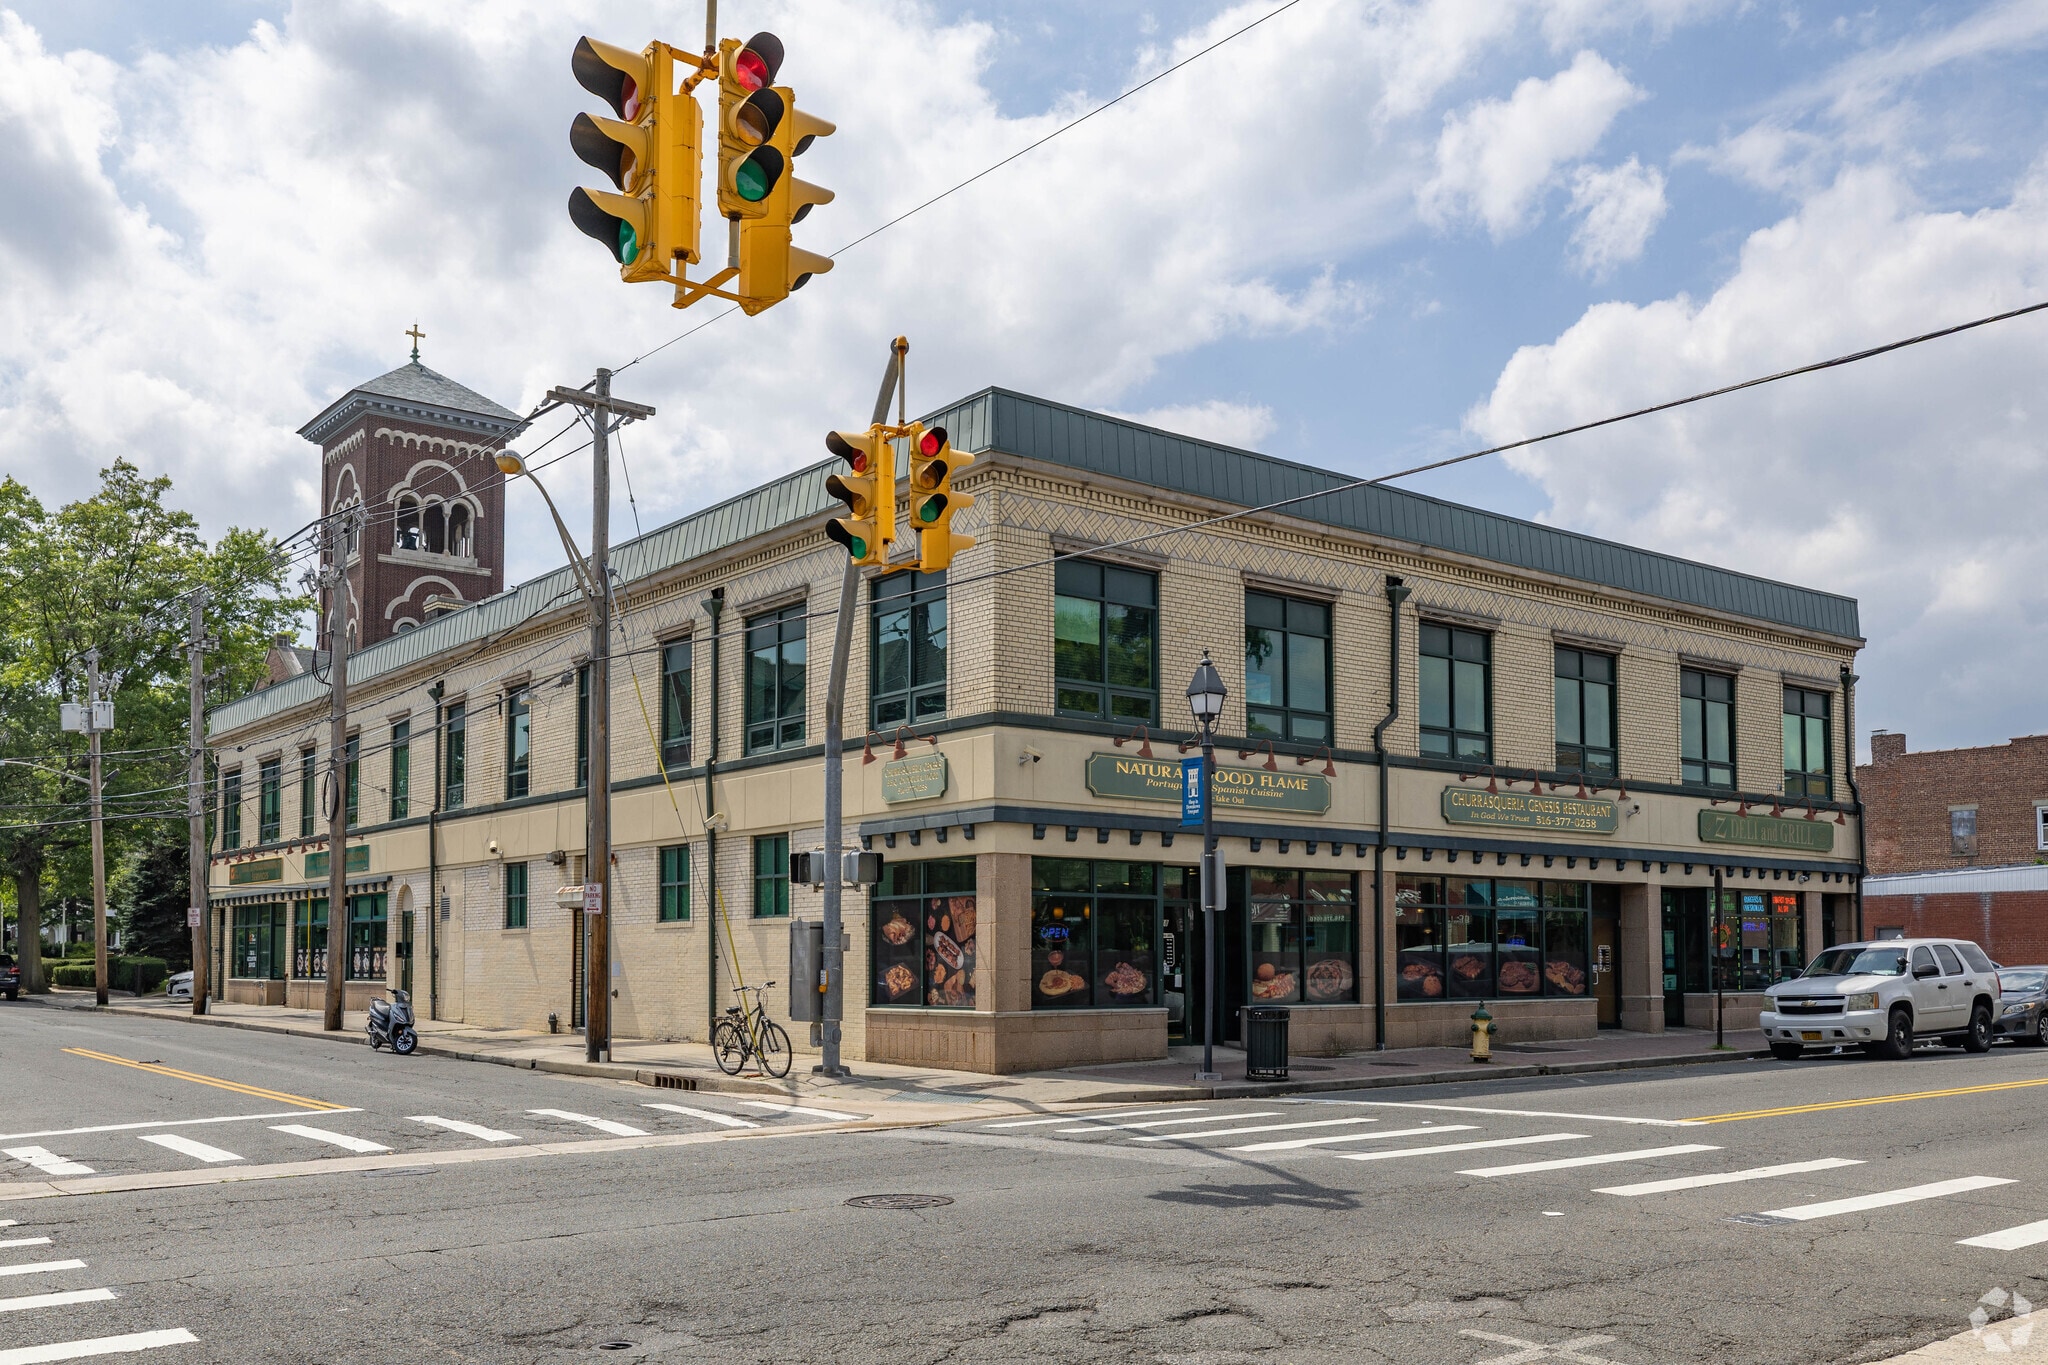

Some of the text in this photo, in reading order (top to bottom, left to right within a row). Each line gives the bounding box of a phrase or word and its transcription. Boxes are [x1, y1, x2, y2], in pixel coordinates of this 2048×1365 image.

[1116, 761, 1308, 791] NATURA OOD FLAME
[1146, 778, 1284, 798] Portug Spanish Cuisine
[1231, 796, 1245, 805] Out
[1452, 792, 1612, 818] CHURRASQUERIA GENESIS RESTAURANT
[1480, 812, 1496, 820] God
[1498, 813, 1509, 821] We
[1510, 814, 1530, 822] Trust
[1536, 815, 1597, 829] 516-377-0258
[1715, 817, 1727, 838] Z
[1731, 819, 1759, 840] DELI
[1761, 823, 1778, 842] and
[1780, 823, 1814, 845] GRILL
[1041, 927, 1068, 939] OPEN
